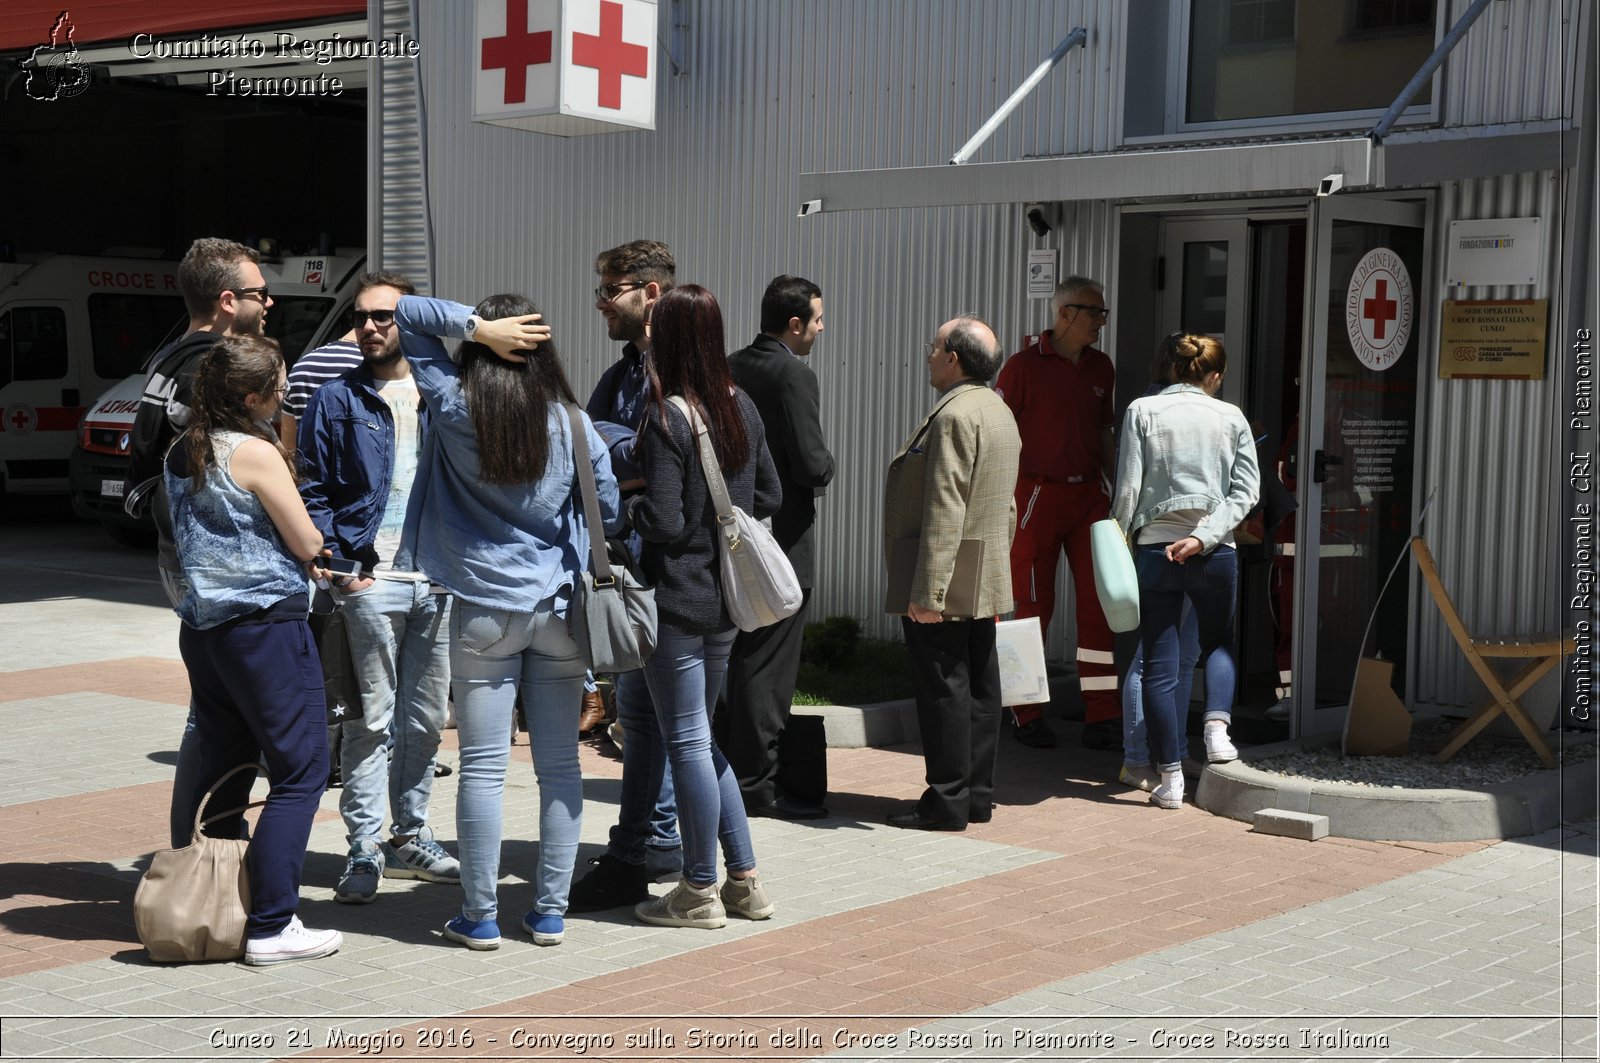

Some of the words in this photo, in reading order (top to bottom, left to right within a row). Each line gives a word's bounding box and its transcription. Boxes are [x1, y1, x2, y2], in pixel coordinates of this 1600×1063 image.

[1459, 240, 1494, 249] FONDAZIONE
[308, 260, 323, 270] 118
[1359, 263, 1370, 280] DI
[1369, 252, 1402, 278] GINEVRA
[88, 270, 156, 289] CROCE
[1399, 275, 1409, 292] 22
[1348, 276, 1374, 364] CONVENZIONE
[1398, 294, 1412, 346] AGOSTO
